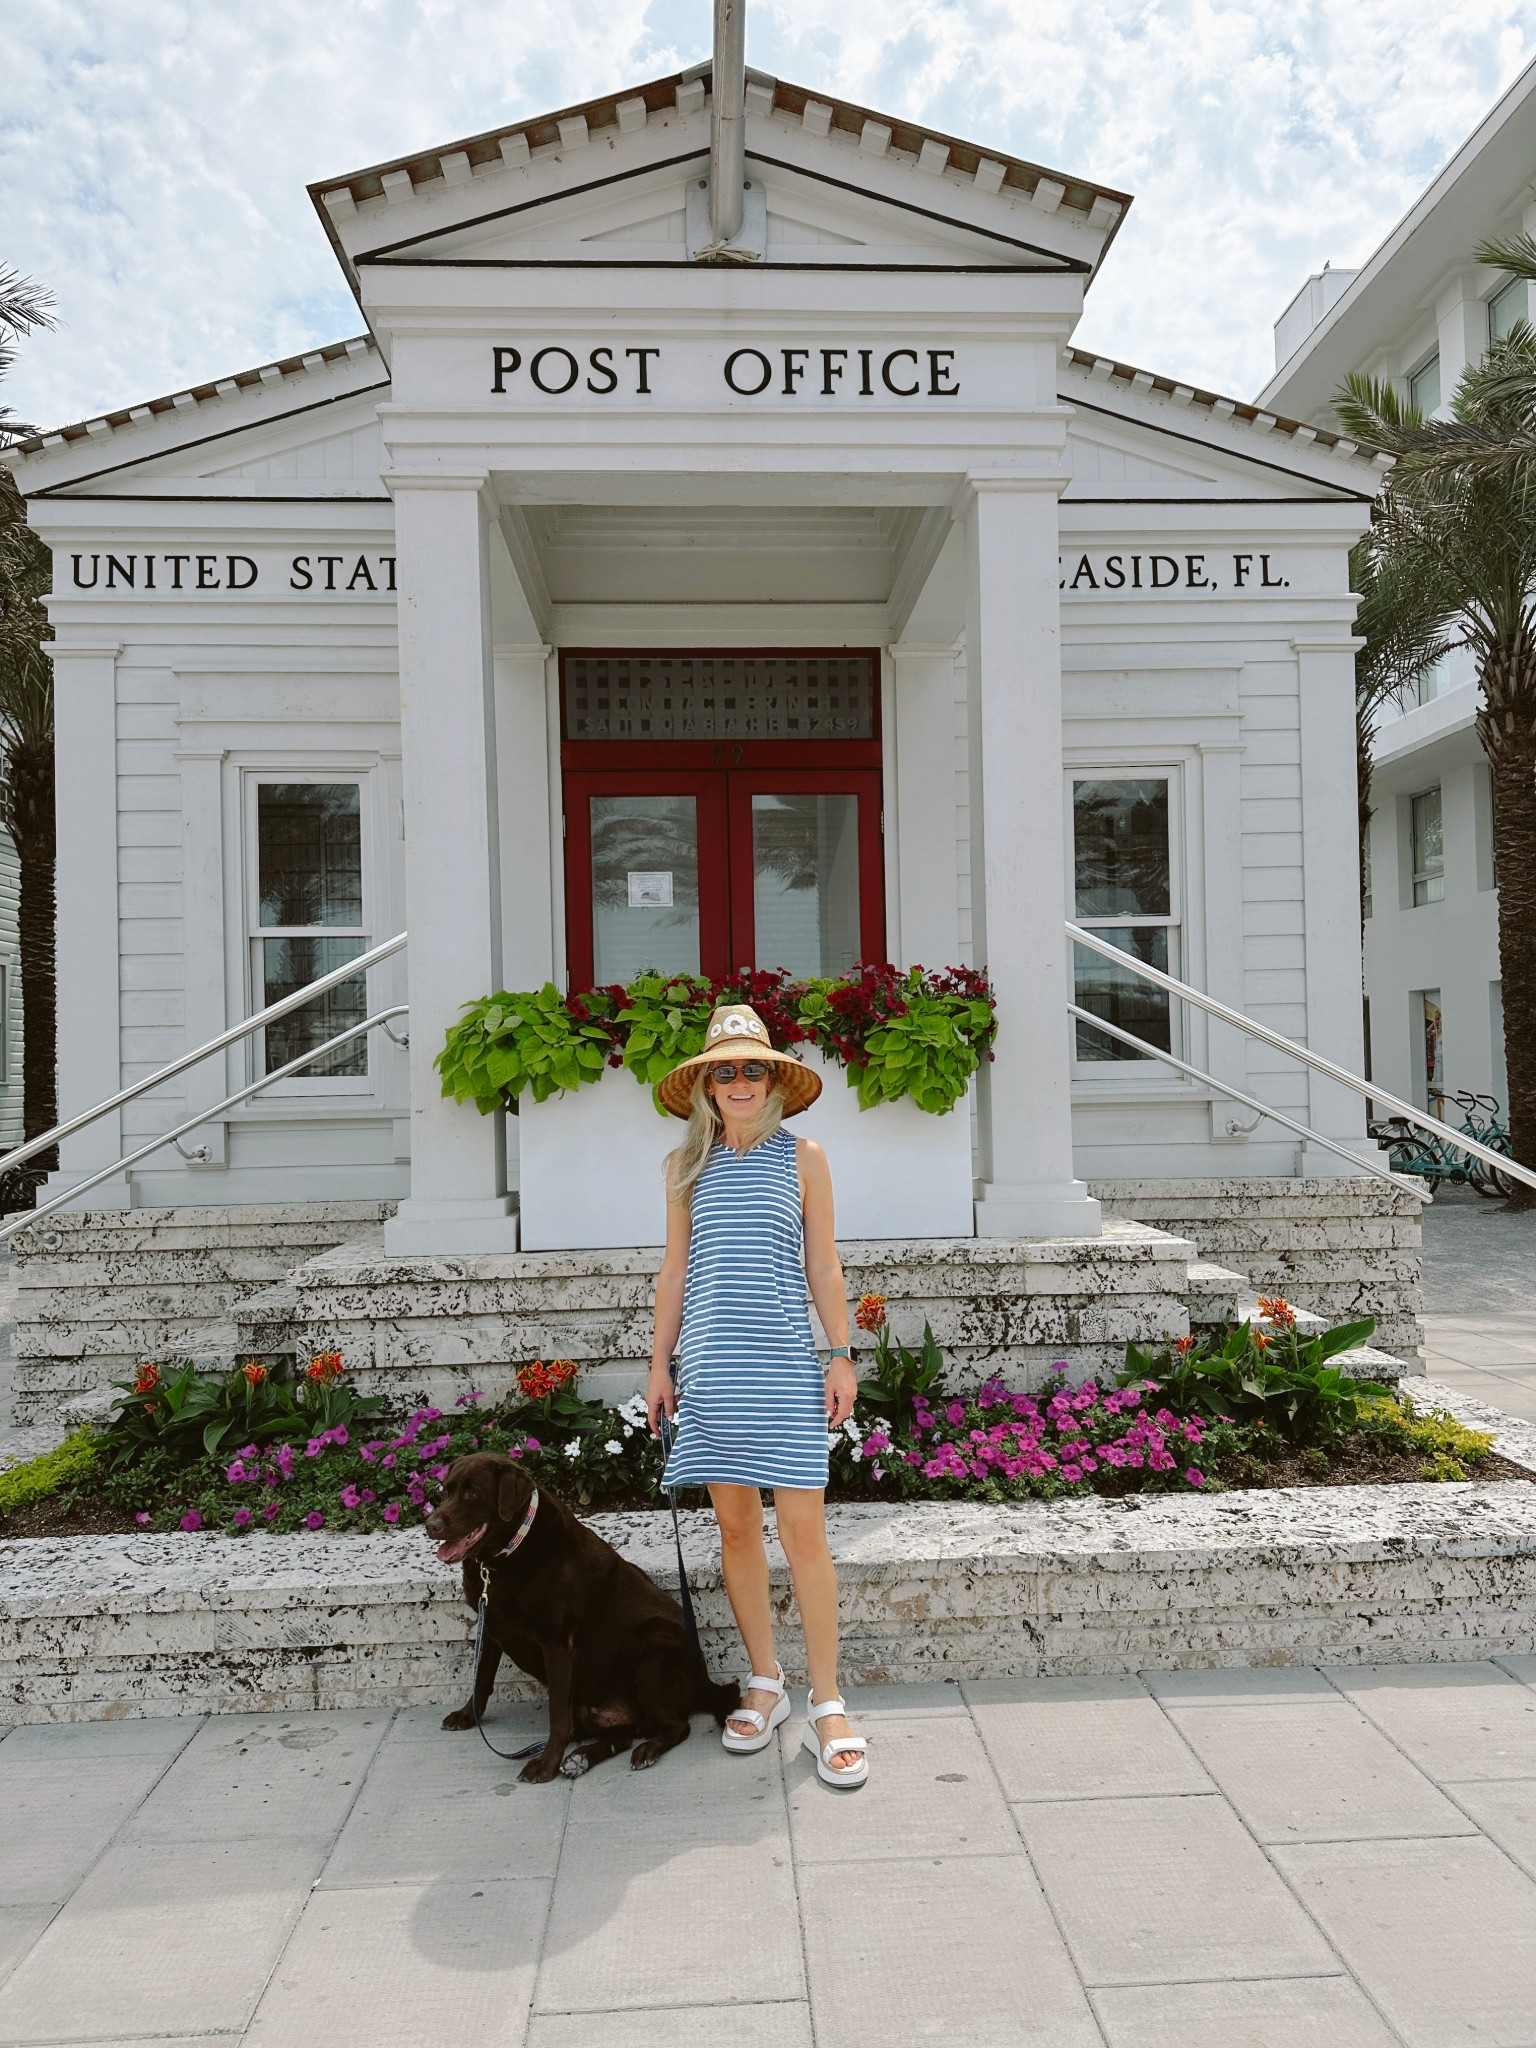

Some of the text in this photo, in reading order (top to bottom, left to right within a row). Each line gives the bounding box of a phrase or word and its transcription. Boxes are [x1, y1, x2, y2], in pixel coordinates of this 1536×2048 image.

[490, 347, 961, 396] POST OFFICE
[71, 554, 397, 590] UNITED STAT
[1233, 554, 1290, 587] FL.
[747, 694, 831, 713] BRANCH
[800, 716, 858, 732] 32459
